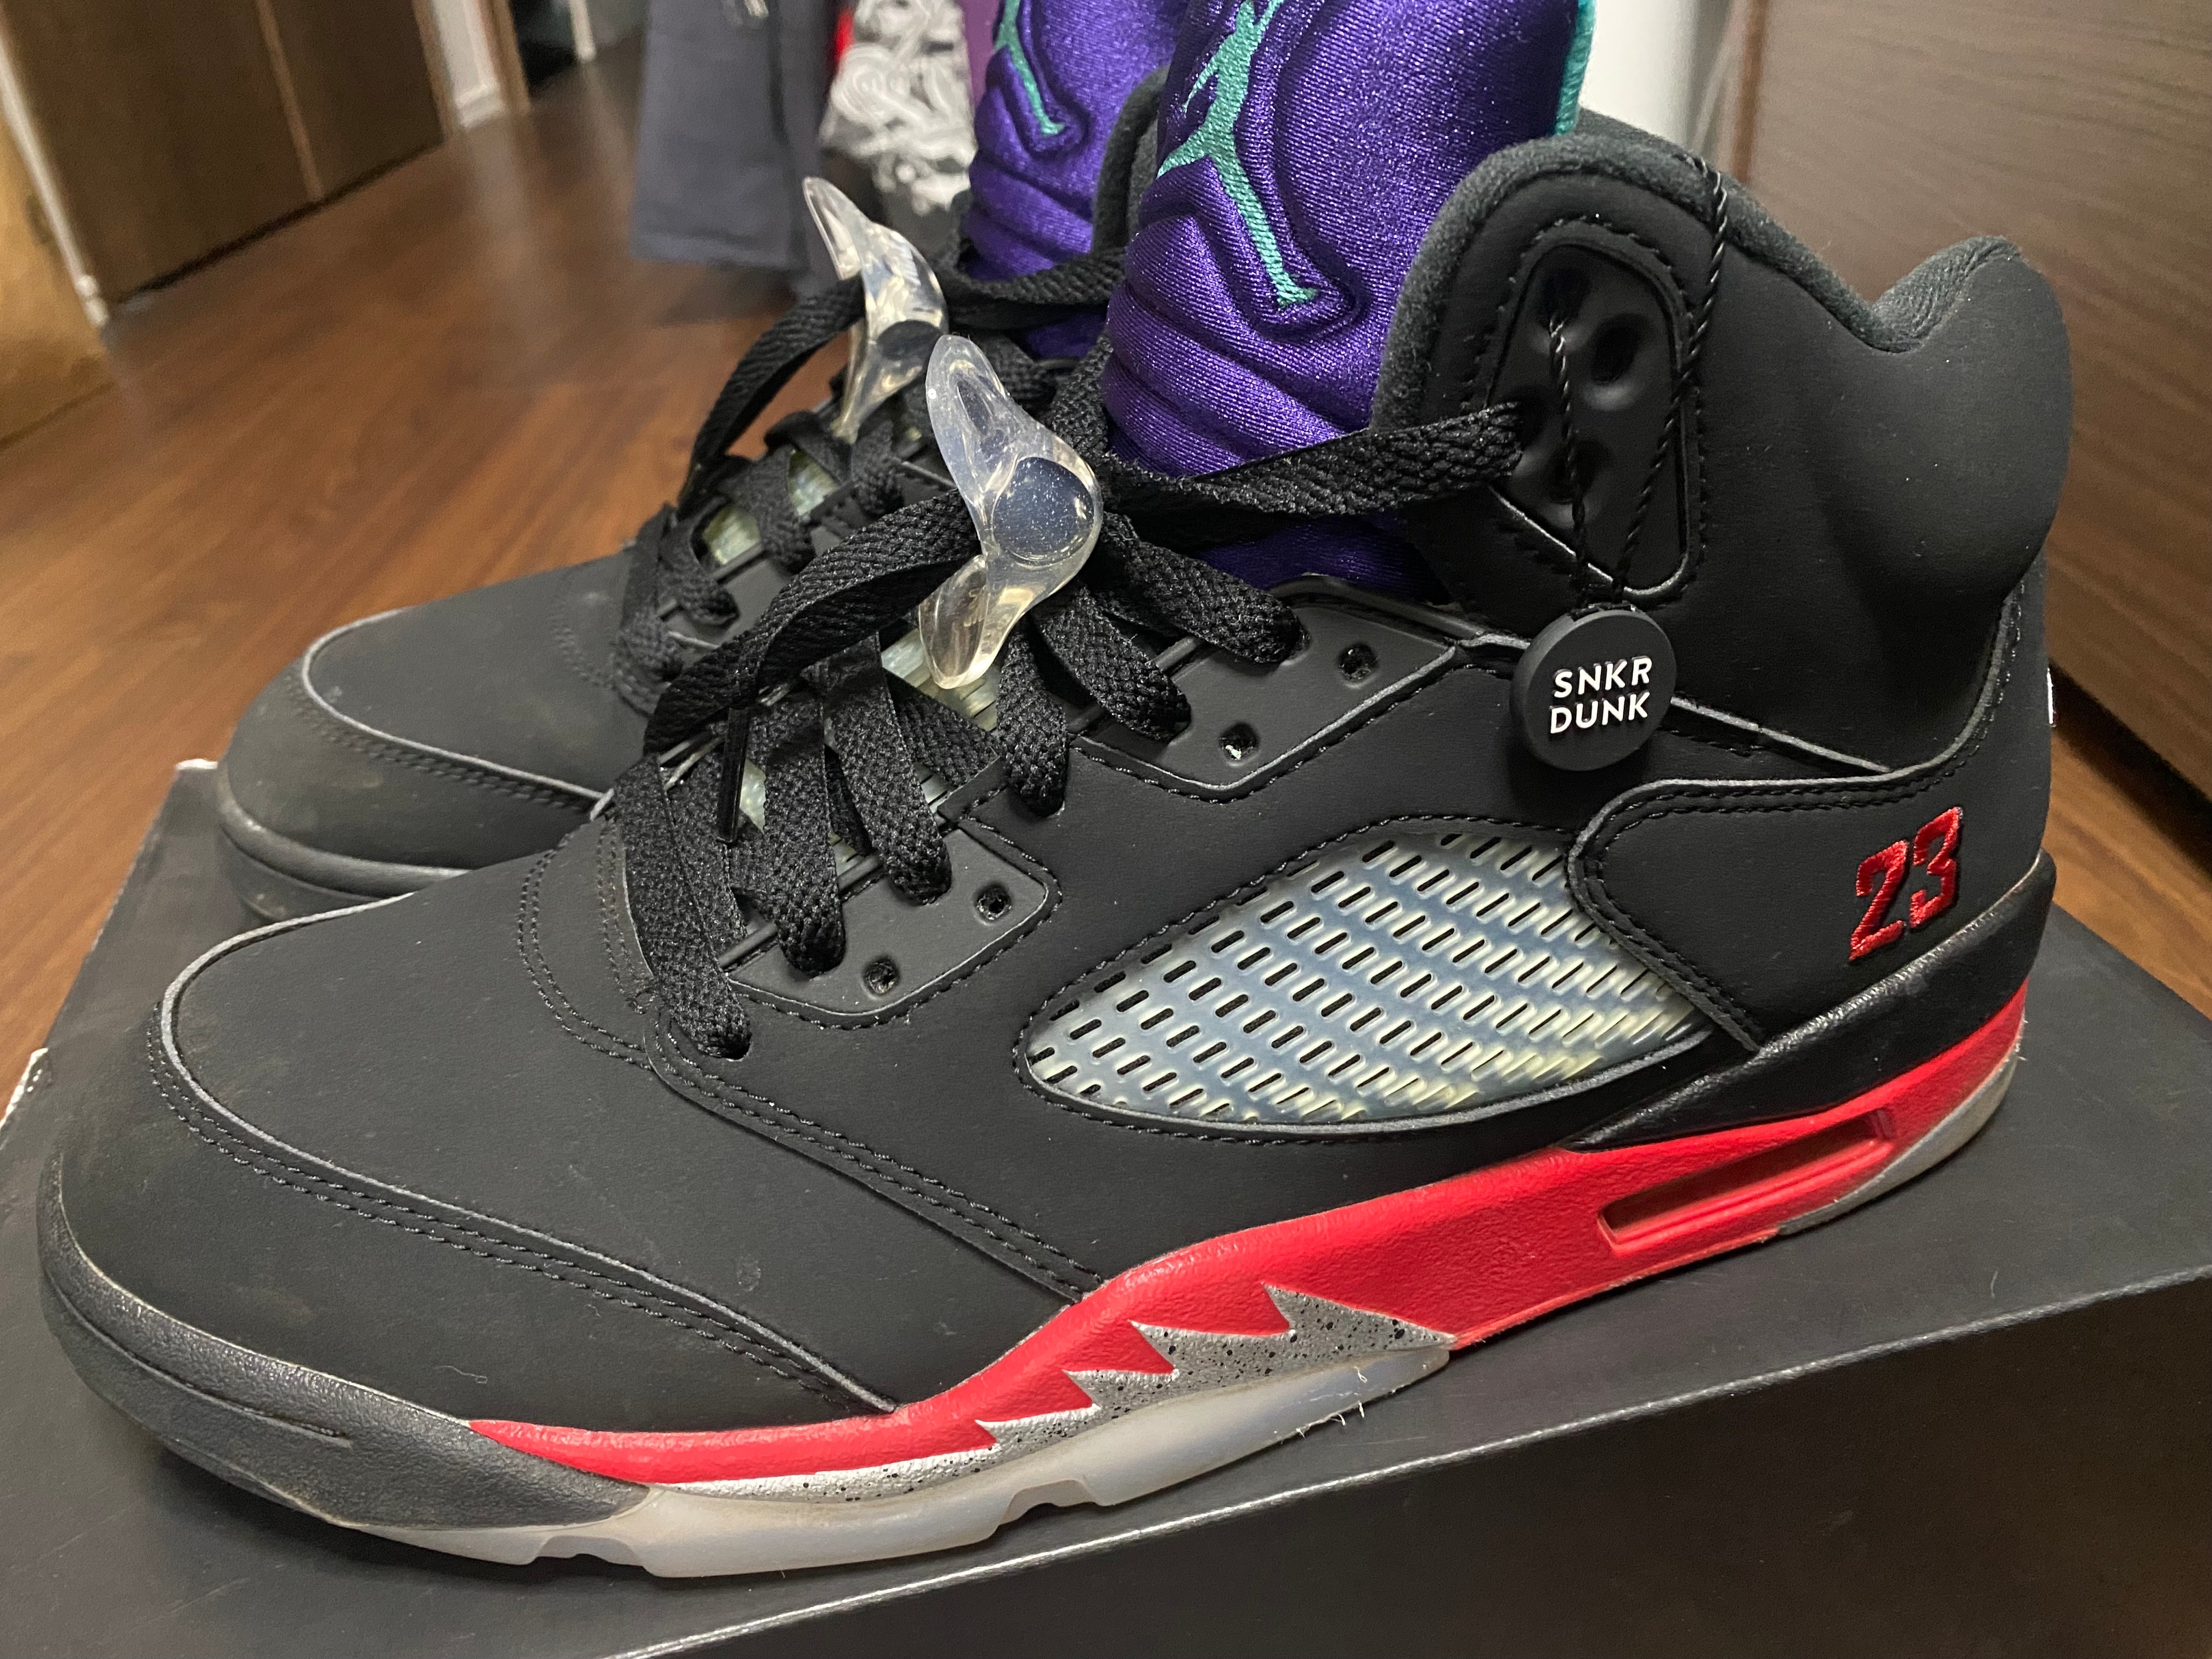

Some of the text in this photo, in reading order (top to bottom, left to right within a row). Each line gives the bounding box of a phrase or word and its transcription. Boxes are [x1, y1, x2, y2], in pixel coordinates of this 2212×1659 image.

[1554, 656, 1652, 698] SNKR
[1549, 691, 1650, 734] DUNK
[1849, 806, 1962, 961] 23
